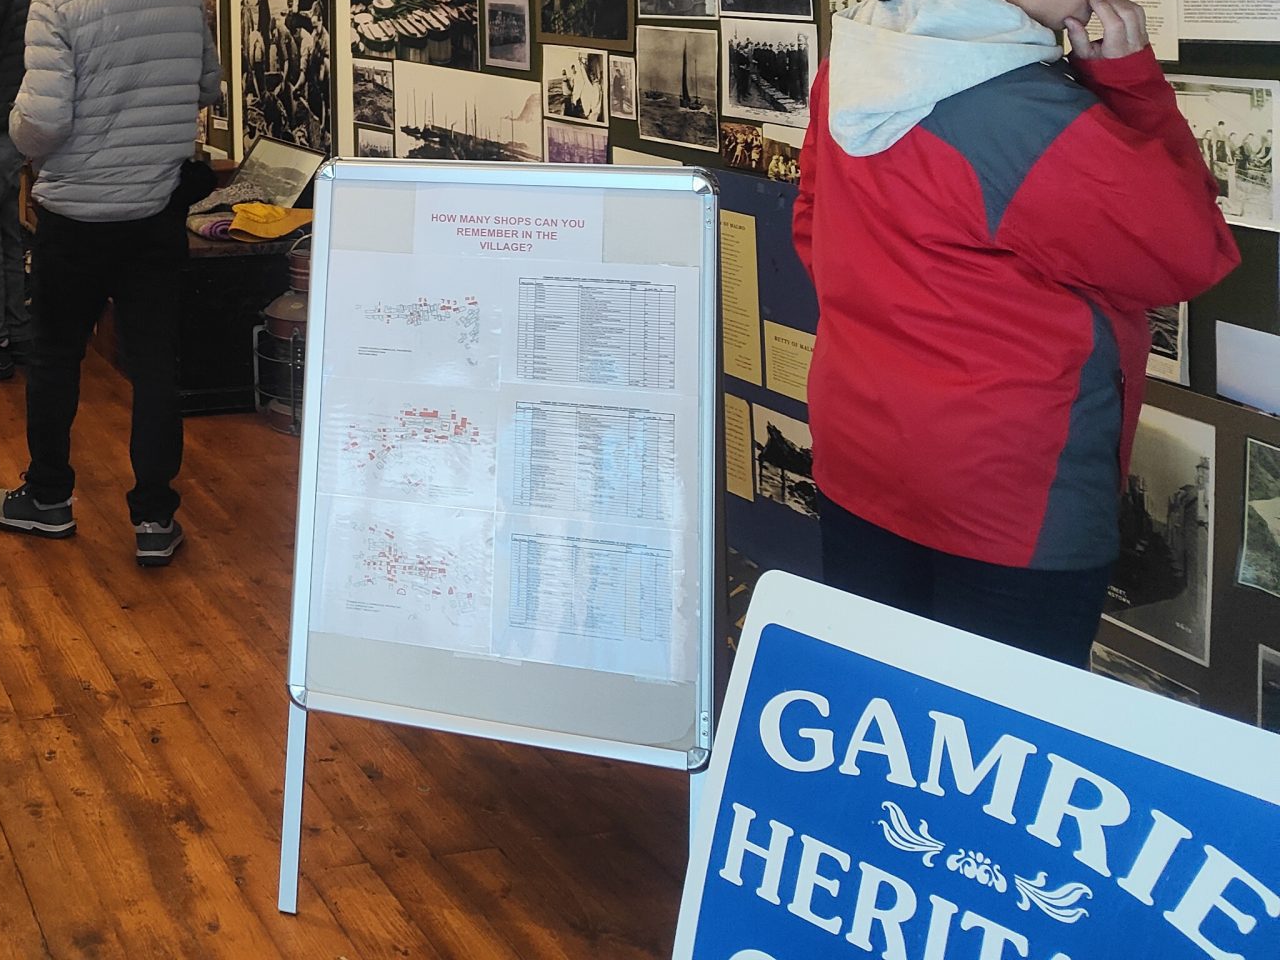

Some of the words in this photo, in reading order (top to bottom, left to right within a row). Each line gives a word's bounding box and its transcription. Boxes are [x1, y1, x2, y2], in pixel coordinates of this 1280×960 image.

[431, 214, 457, 223] HOW
[459, 215, 490, 224] MANY
[494, 216, 531, 226] SHOPS
[534, 218, 558, 227] CAN
[561, 219, 585, 228] YOU
[457, 228, 518, 238] REMEMBER
[522, 230, 532, 239] IN
[536, 231, 557, 240] THE
[480, 242, 533, 252] VILLAGE?
[758, 689, 1280, 960] GAMRIE
[719, 803, 1076, 960] HERIT
